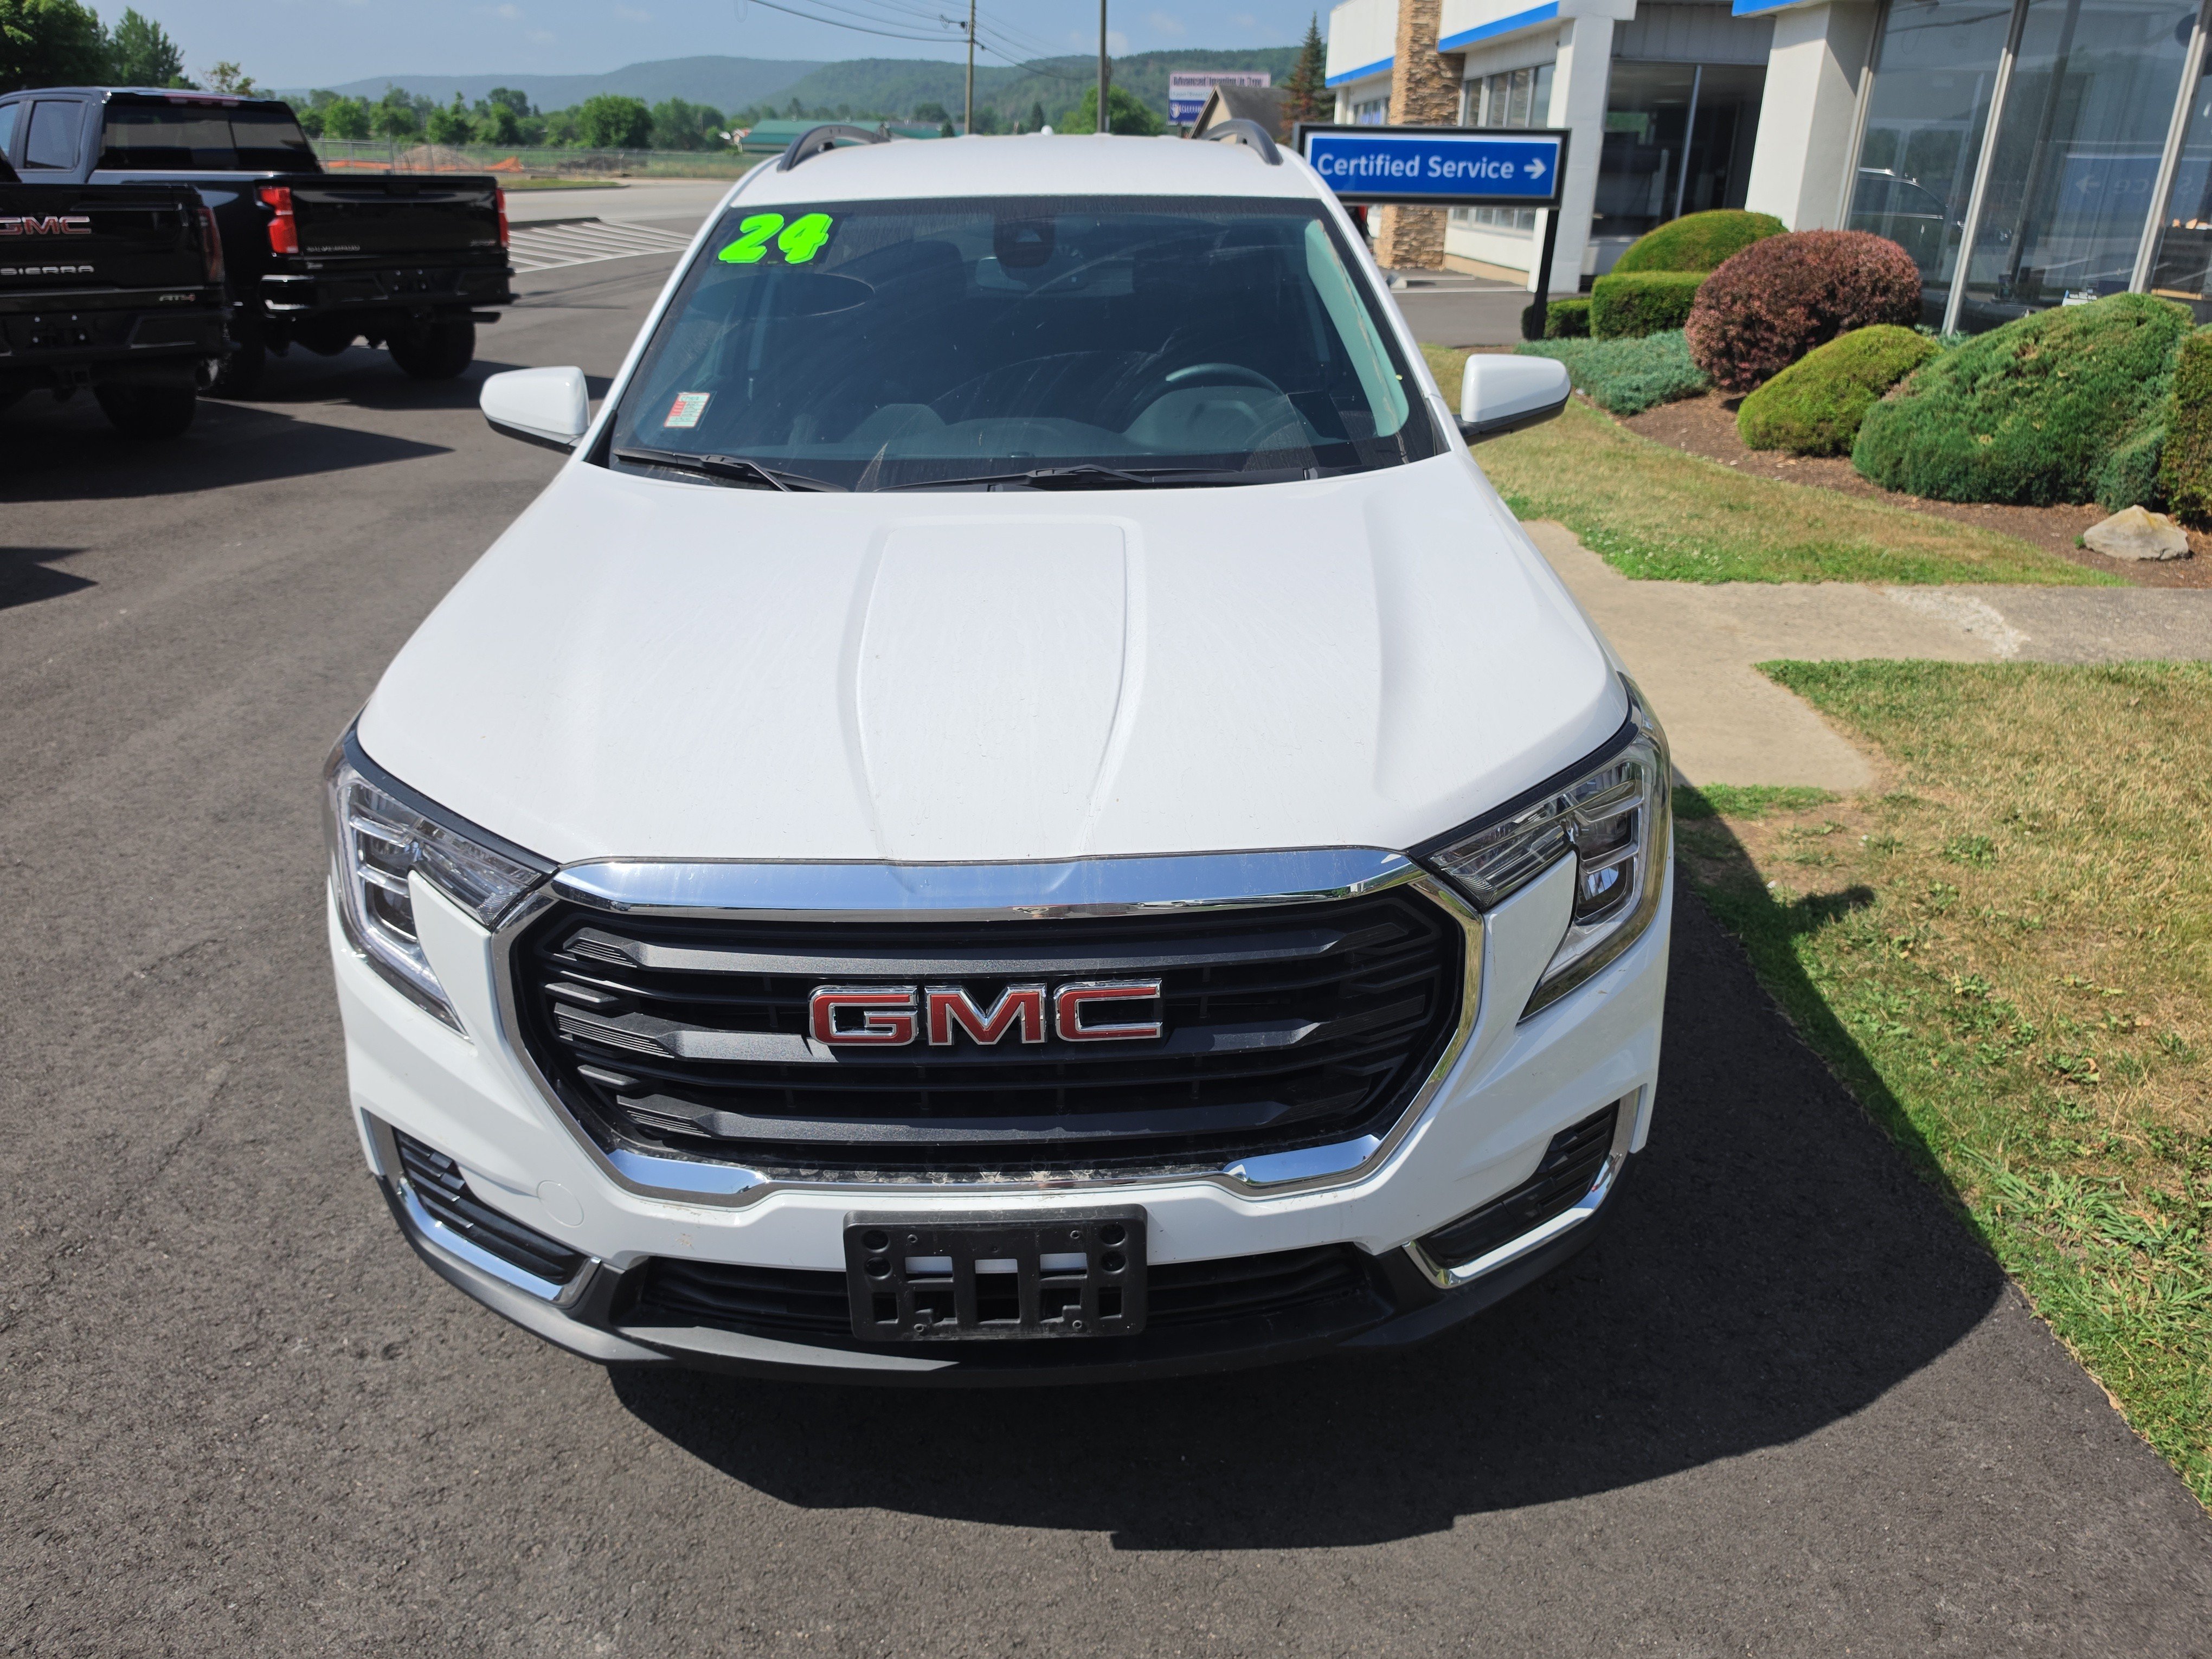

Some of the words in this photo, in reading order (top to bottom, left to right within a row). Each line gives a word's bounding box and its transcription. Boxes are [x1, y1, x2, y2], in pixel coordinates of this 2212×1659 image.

[1317, 153, 1420, 177] Certified
[1427, 155, 1515, 179] Service
[0, 216, 92, 235] GMC
[718, 213, 833, 265] 24
[0, 265, 94, 275] SIERRA
[159, 294, 196, 302] AT4
[809, 978, 1163, 1046] GMC
